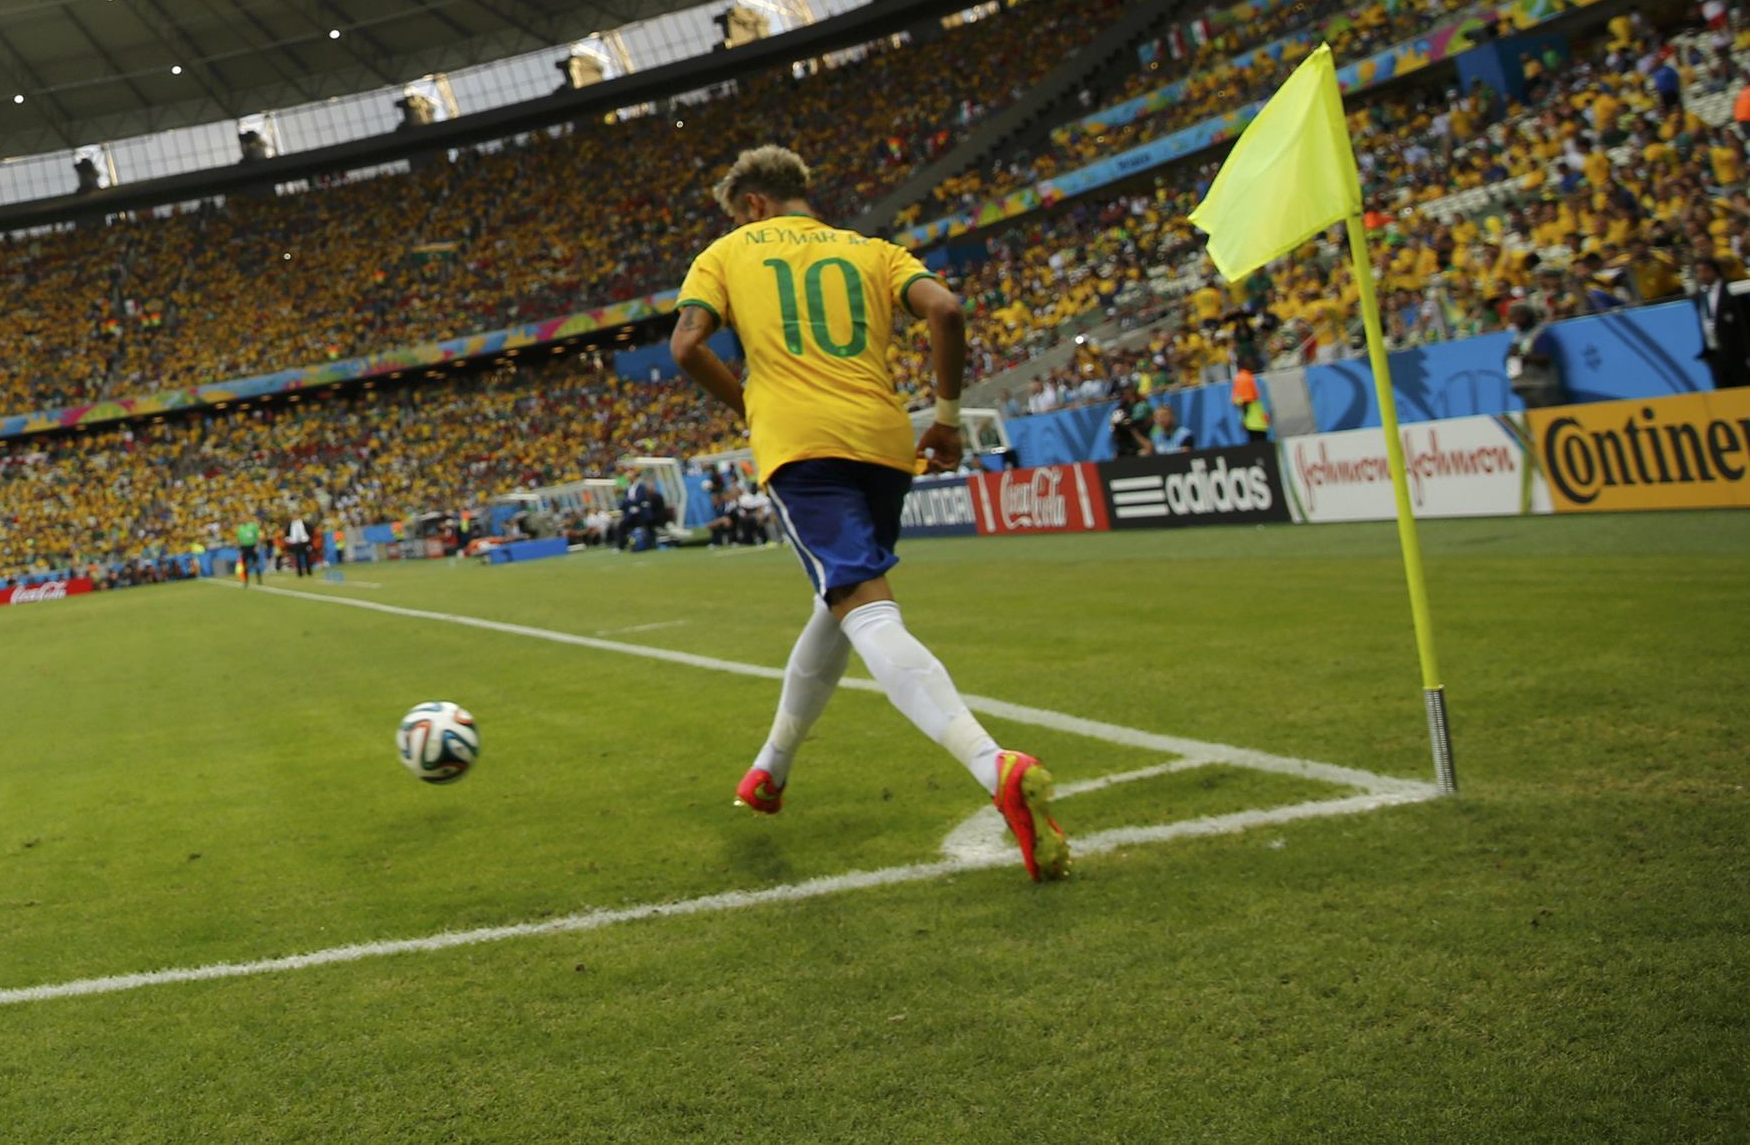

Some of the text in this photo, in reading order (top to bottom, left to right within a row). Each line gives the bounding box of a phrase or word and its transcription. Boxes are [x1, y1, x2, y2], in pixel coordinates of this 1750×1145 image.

[745, 227, 838, 246] NEYMAR
[763, 257, 867, 358] 10
[1165, 456, 1272, 515] adidas
